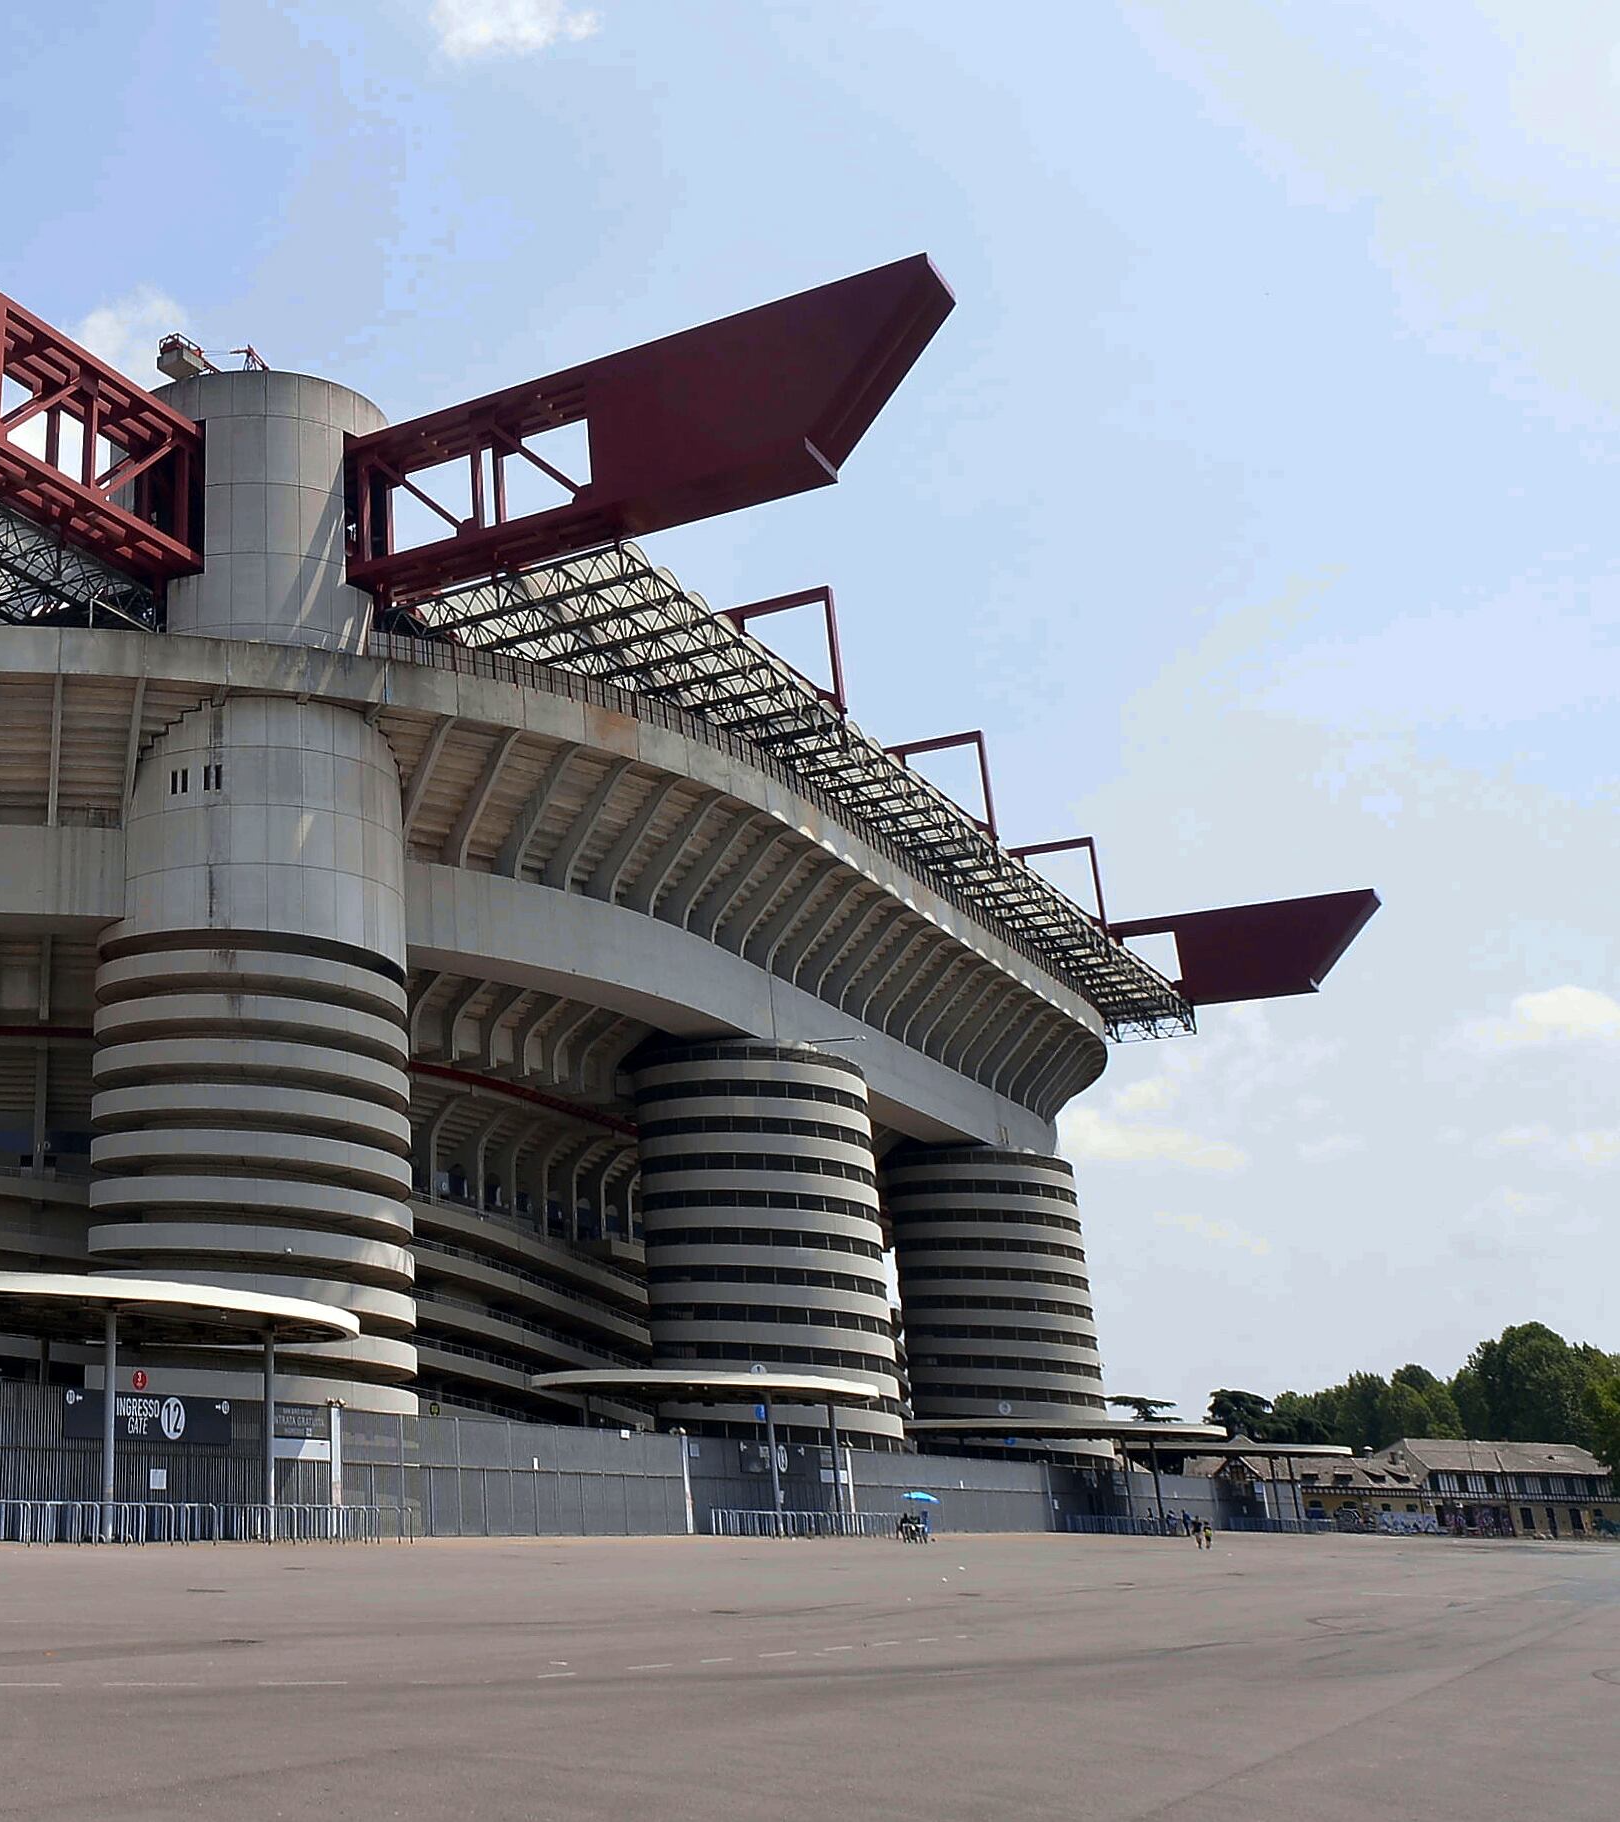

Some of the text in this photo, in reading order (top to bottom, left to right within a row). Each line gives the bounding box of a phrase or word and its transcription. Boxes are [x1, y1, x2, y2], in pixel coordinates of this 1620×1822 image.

[116, 1396, 160, 1419] INGRESSO
[164, 1402, 182, 1434] 12
[127, 1416, 149, 1435] GATE
